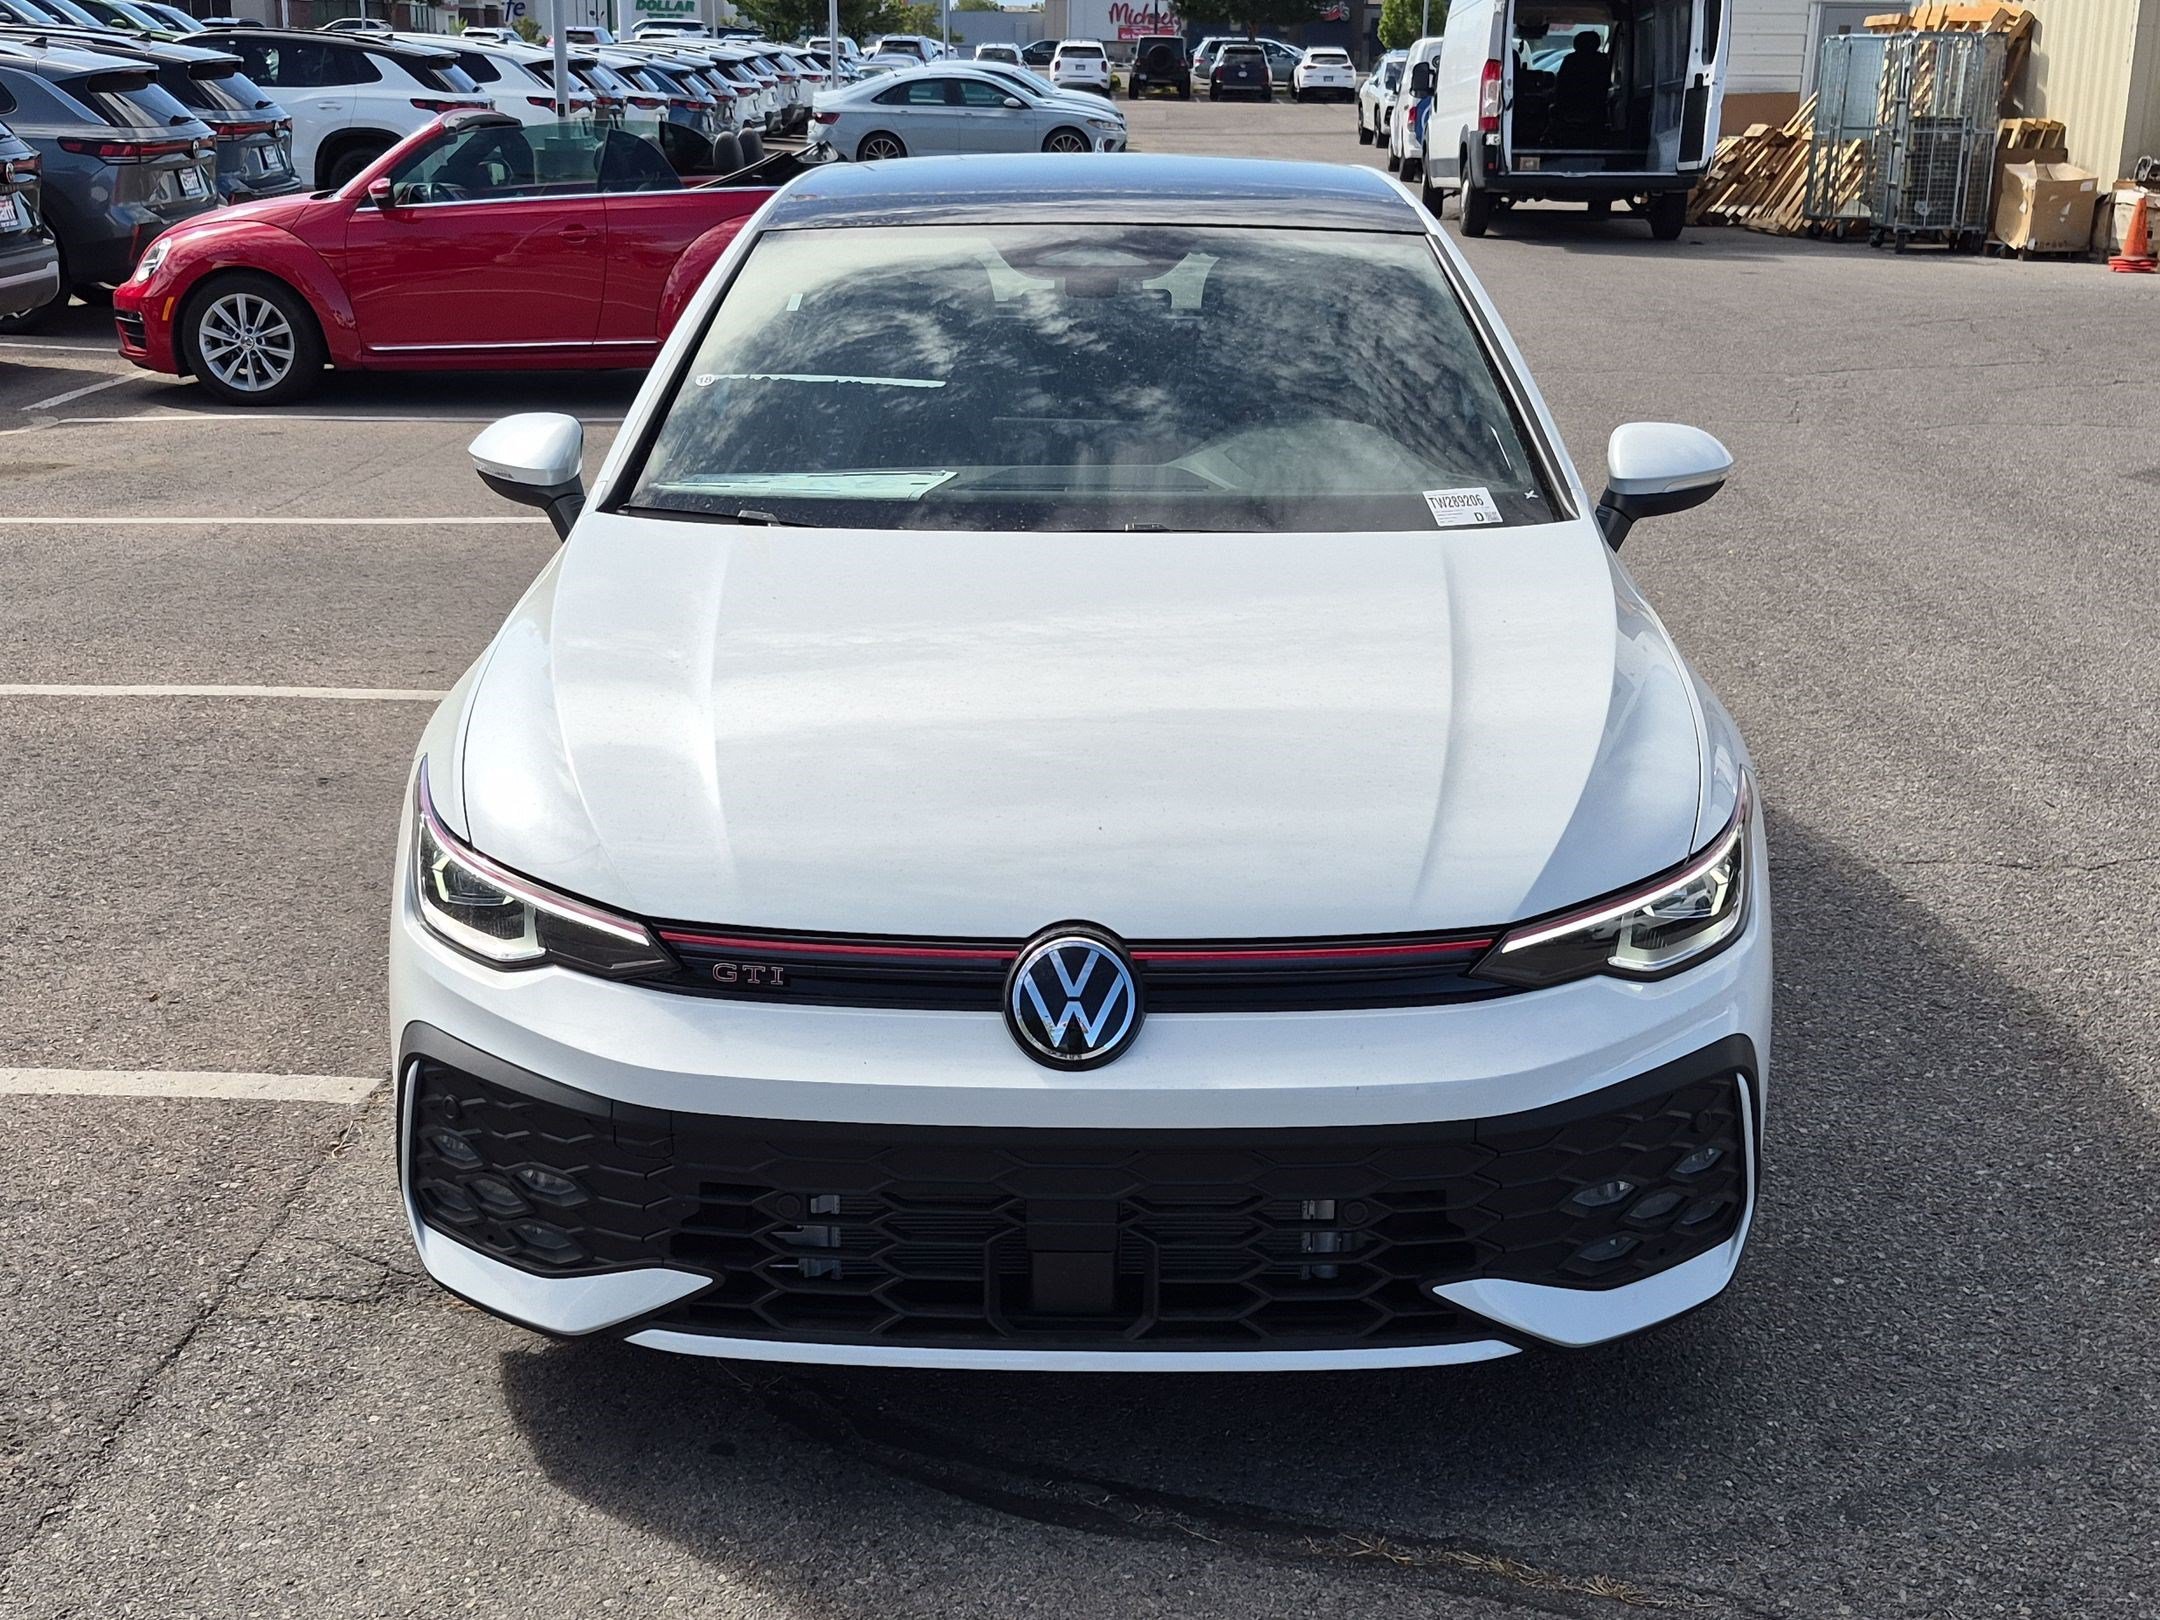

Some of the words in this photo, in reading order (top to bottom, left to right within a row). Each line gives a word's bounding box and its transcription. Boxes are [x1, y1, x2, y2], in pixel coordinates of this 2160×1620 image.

[636, 0, 695, 12] DOLLAR
[1428, 495, 1484, 509] TW289206
[1474, 512, 1485, 521] D
[712, 962, 784, 985] GTI
